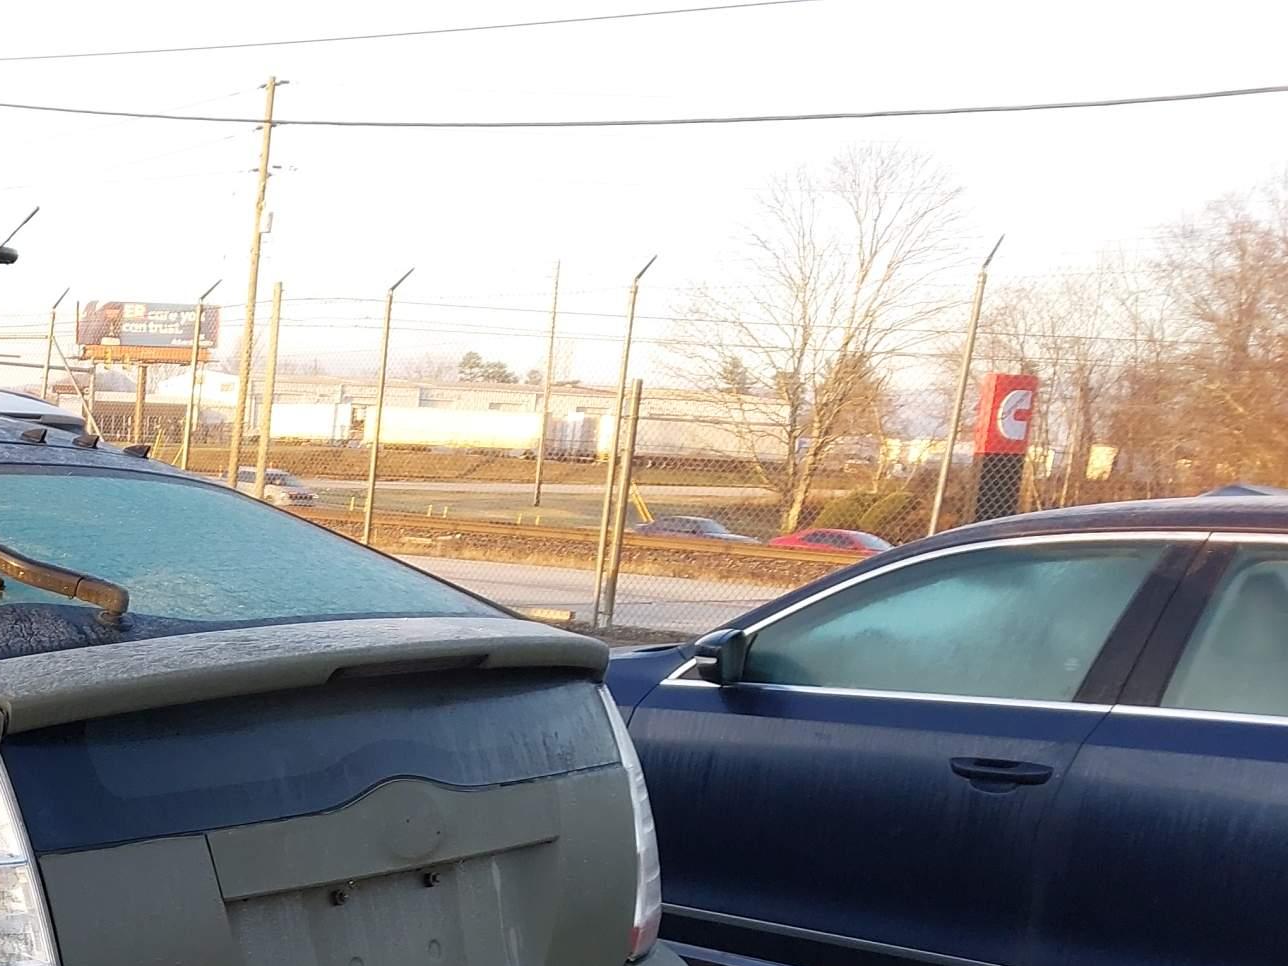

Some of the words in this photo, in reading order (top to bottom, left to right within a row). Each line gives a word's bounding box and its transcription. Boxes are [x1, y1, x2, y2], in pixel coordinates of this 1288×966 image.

[123, 303, 146, 318] ER
[148, 311, 178, 320] care
[123, 323, 147, 333] can
